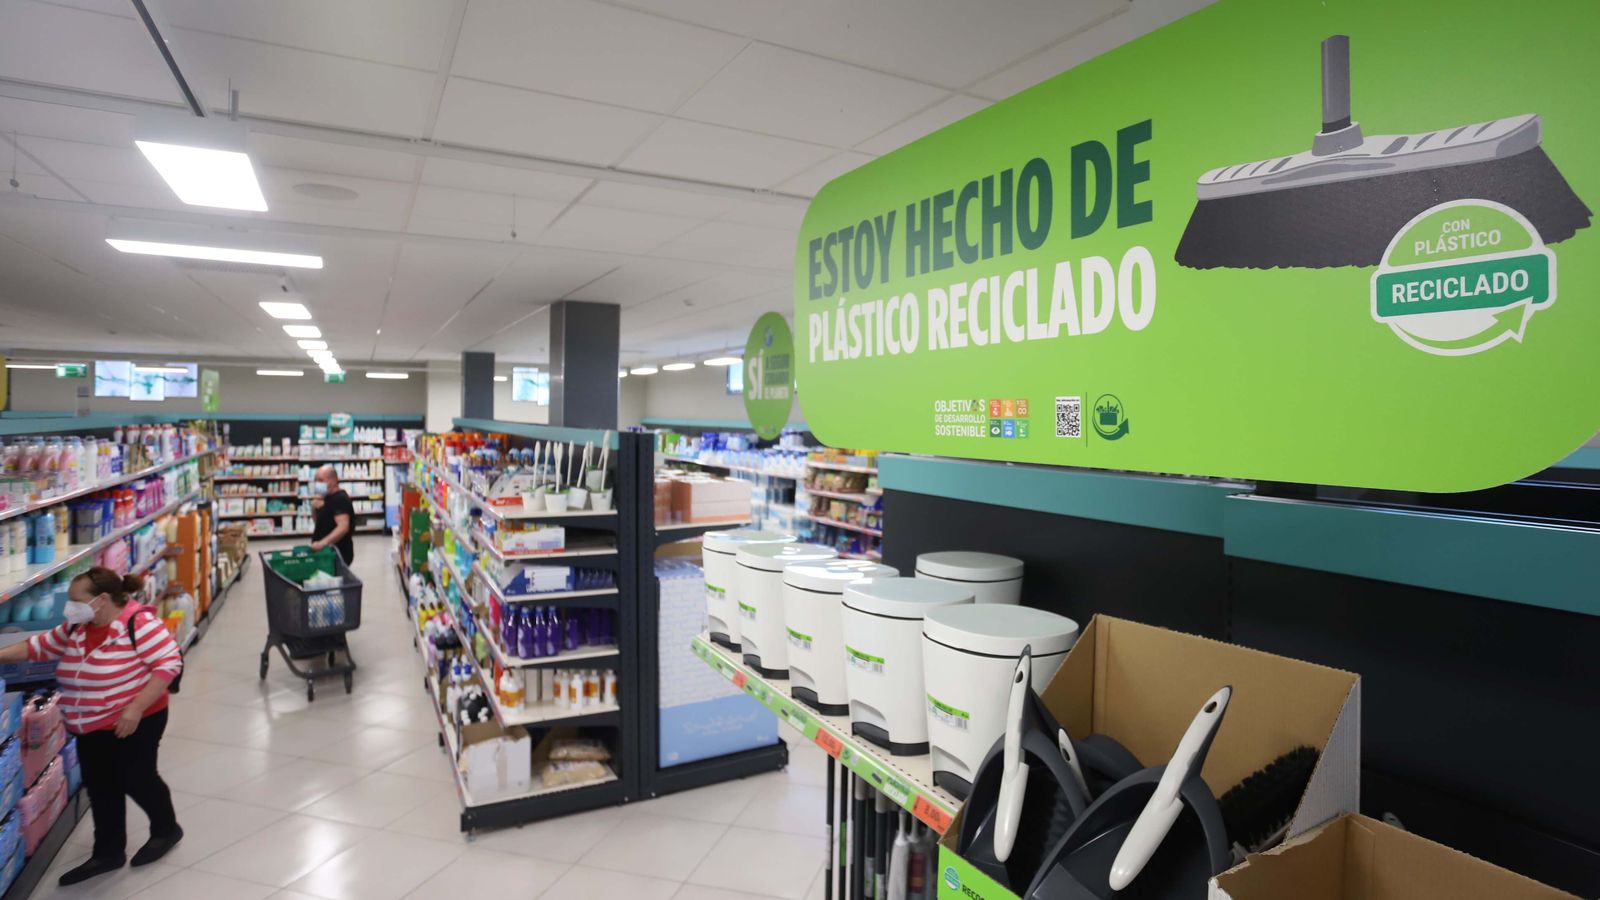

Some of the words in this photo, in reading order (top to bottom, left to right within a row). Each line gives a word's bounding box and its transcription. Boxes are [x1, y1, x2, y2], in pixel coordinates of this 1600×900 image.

[808, 210, 897, 301] ESTOY
[905, 157, 1053, 279] HECHO
[1070, 118, 1153, 240] DE
[1442, 218, 1470, 233] CON
[1414, 229, 1502, 256] PLÁSTICO
[1392, 269, 1529, 304] RECICLADO
[808, 291, 920, 363] PLÁSTICO
[928, 245, 1157, 351] RECICLADO
[943, 414, 986, 424] DESARROLLO
[935, 425, 986, 438] SOSTENIBLE
[962, 884, 985, 900] RECO
